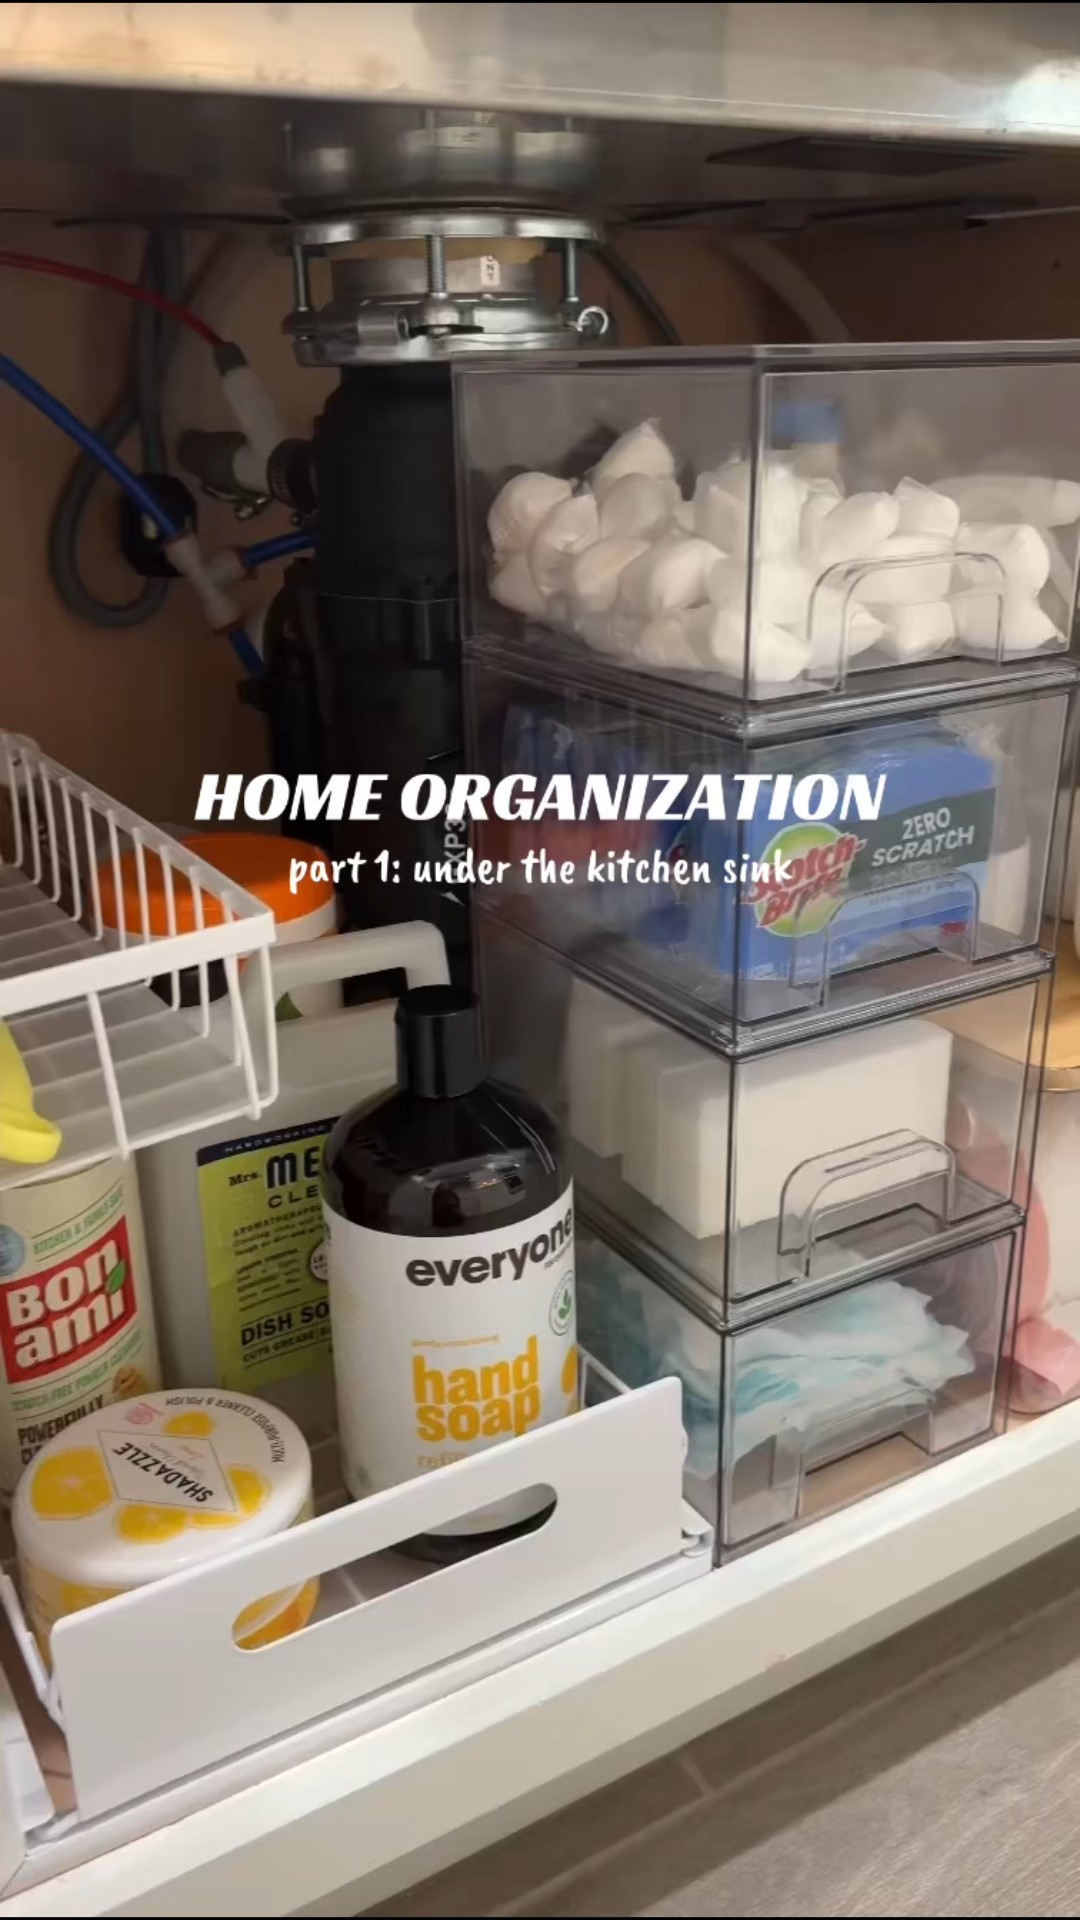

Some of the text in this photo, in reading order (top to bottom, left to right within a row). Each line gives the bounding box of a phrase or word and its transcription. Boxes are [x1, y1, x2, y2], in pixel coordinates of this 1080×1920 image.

[872, 825, 974, 867] SCRATCH
[902, 807, 951, 840] ZERO
[228, 1171, 262, 1187] Mrs.
[406, 1208, 572, 1287] everyone
[7, 1240, 119, 1328] Bon
[14, 1286, 125, 1369] ami
[242, 1313, 293, 1346] DISH
[412, 1335, 539, 1405] hand
[165, 1396, 204, 1407] POLISH
[416, 1385, 541, 1443] soap
[113, 1442, 215, 1503] SHADAZZLE
